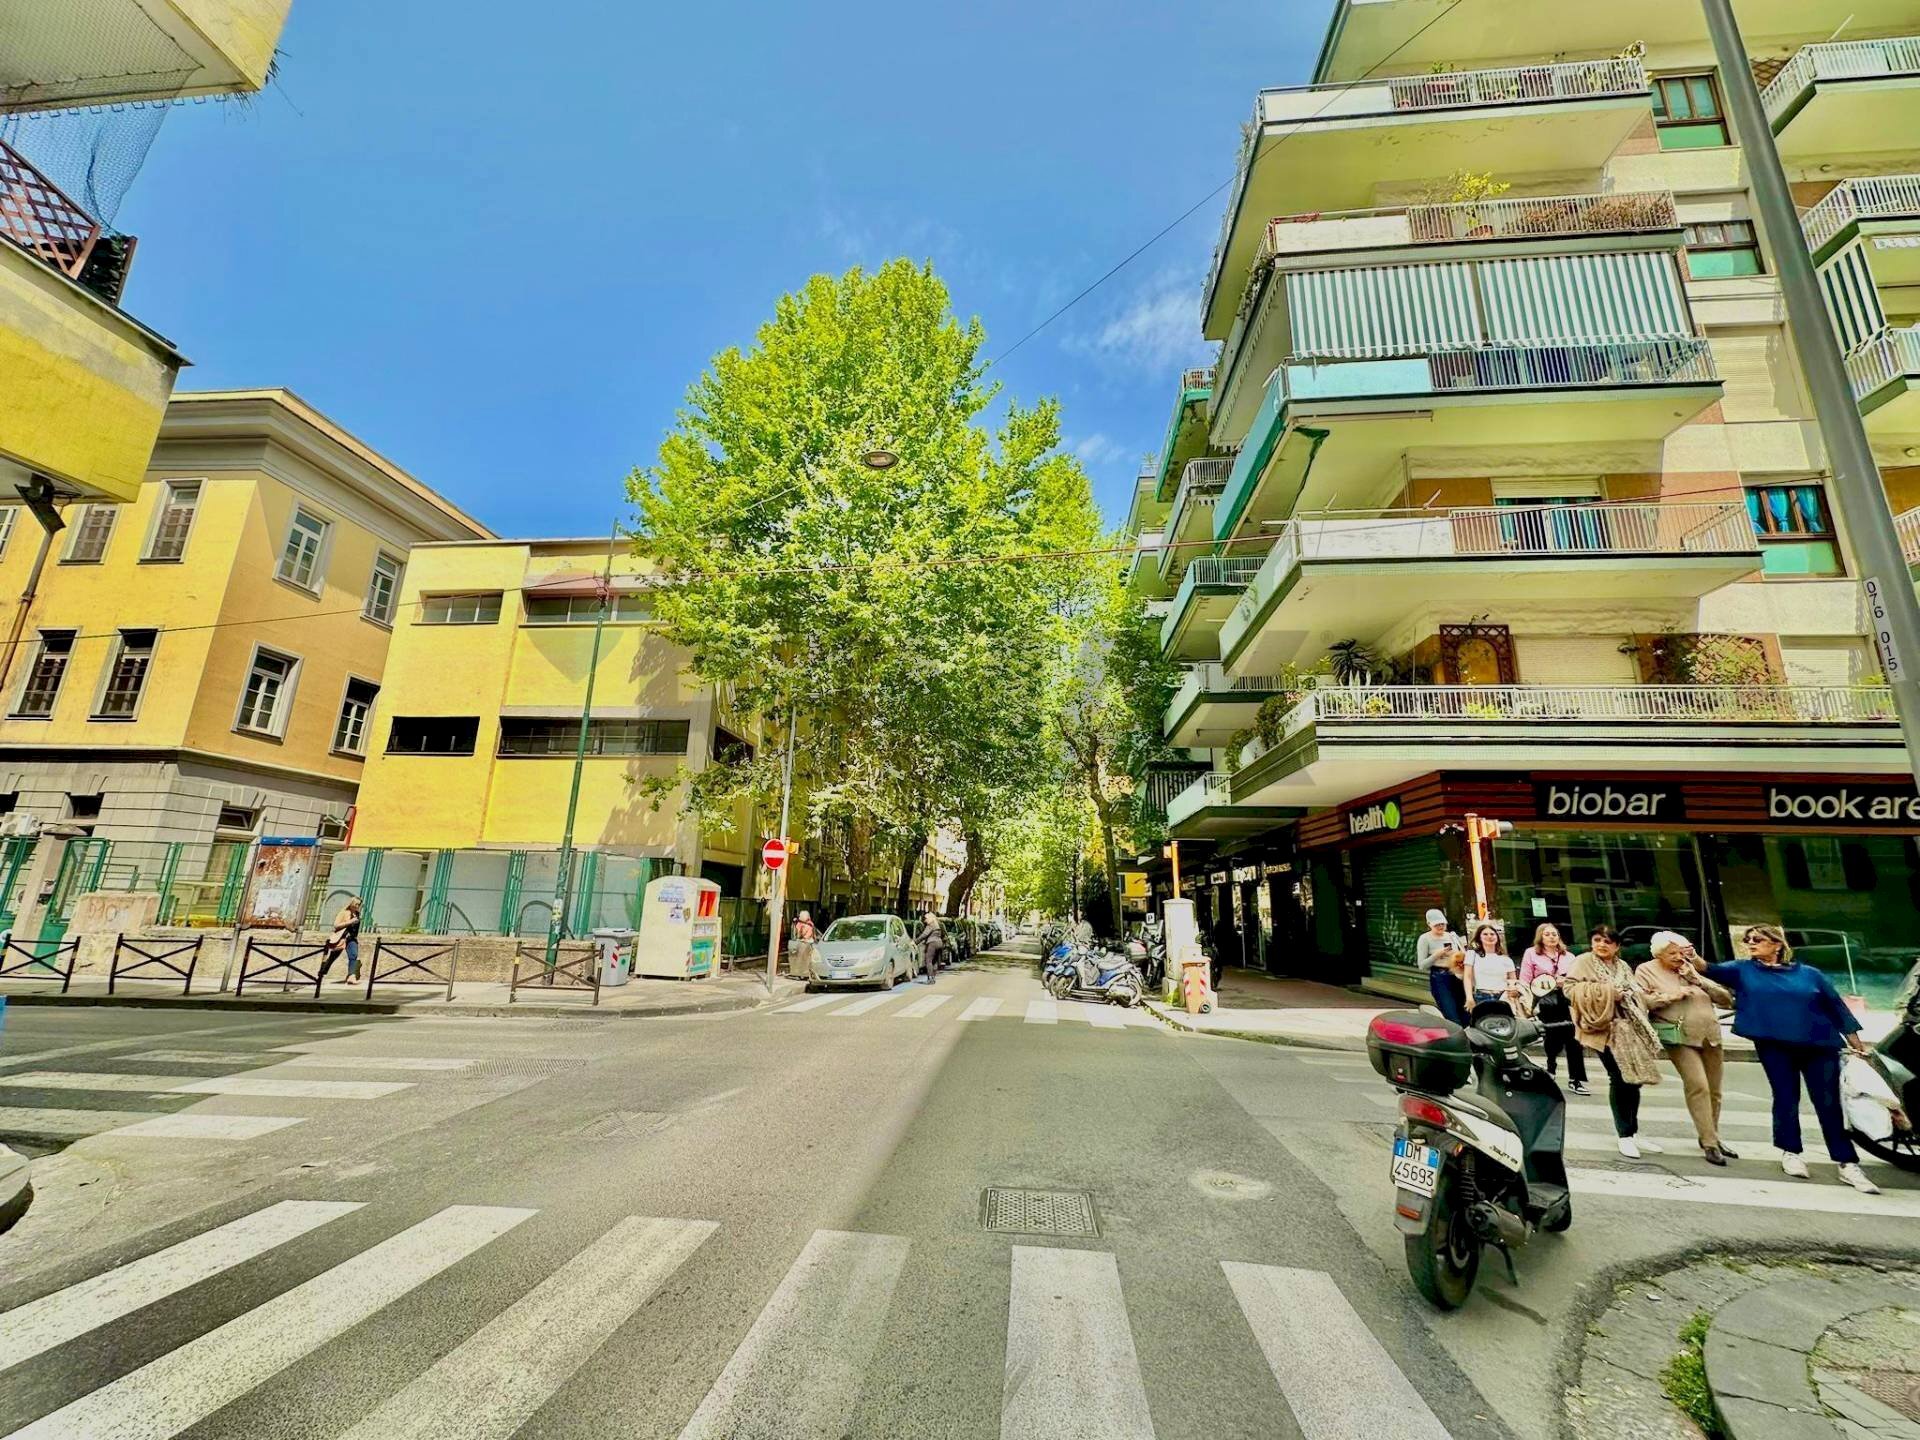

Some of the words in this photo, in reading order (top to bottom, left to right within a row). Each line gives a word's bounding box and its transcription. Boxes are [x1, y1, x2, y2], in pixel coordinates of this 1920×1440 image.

[1866, 581, 1884, 619] 076
[1881, 631, 1898, 671] 015
[1547, 785, 1667, 815] biobar
[1769, 787, 1865, 818] book
[1349, 804, 1386, 834] health
[1405, 1141, 1422, 1161] DM
[1394, 1161, 1435, 1187] 45693
